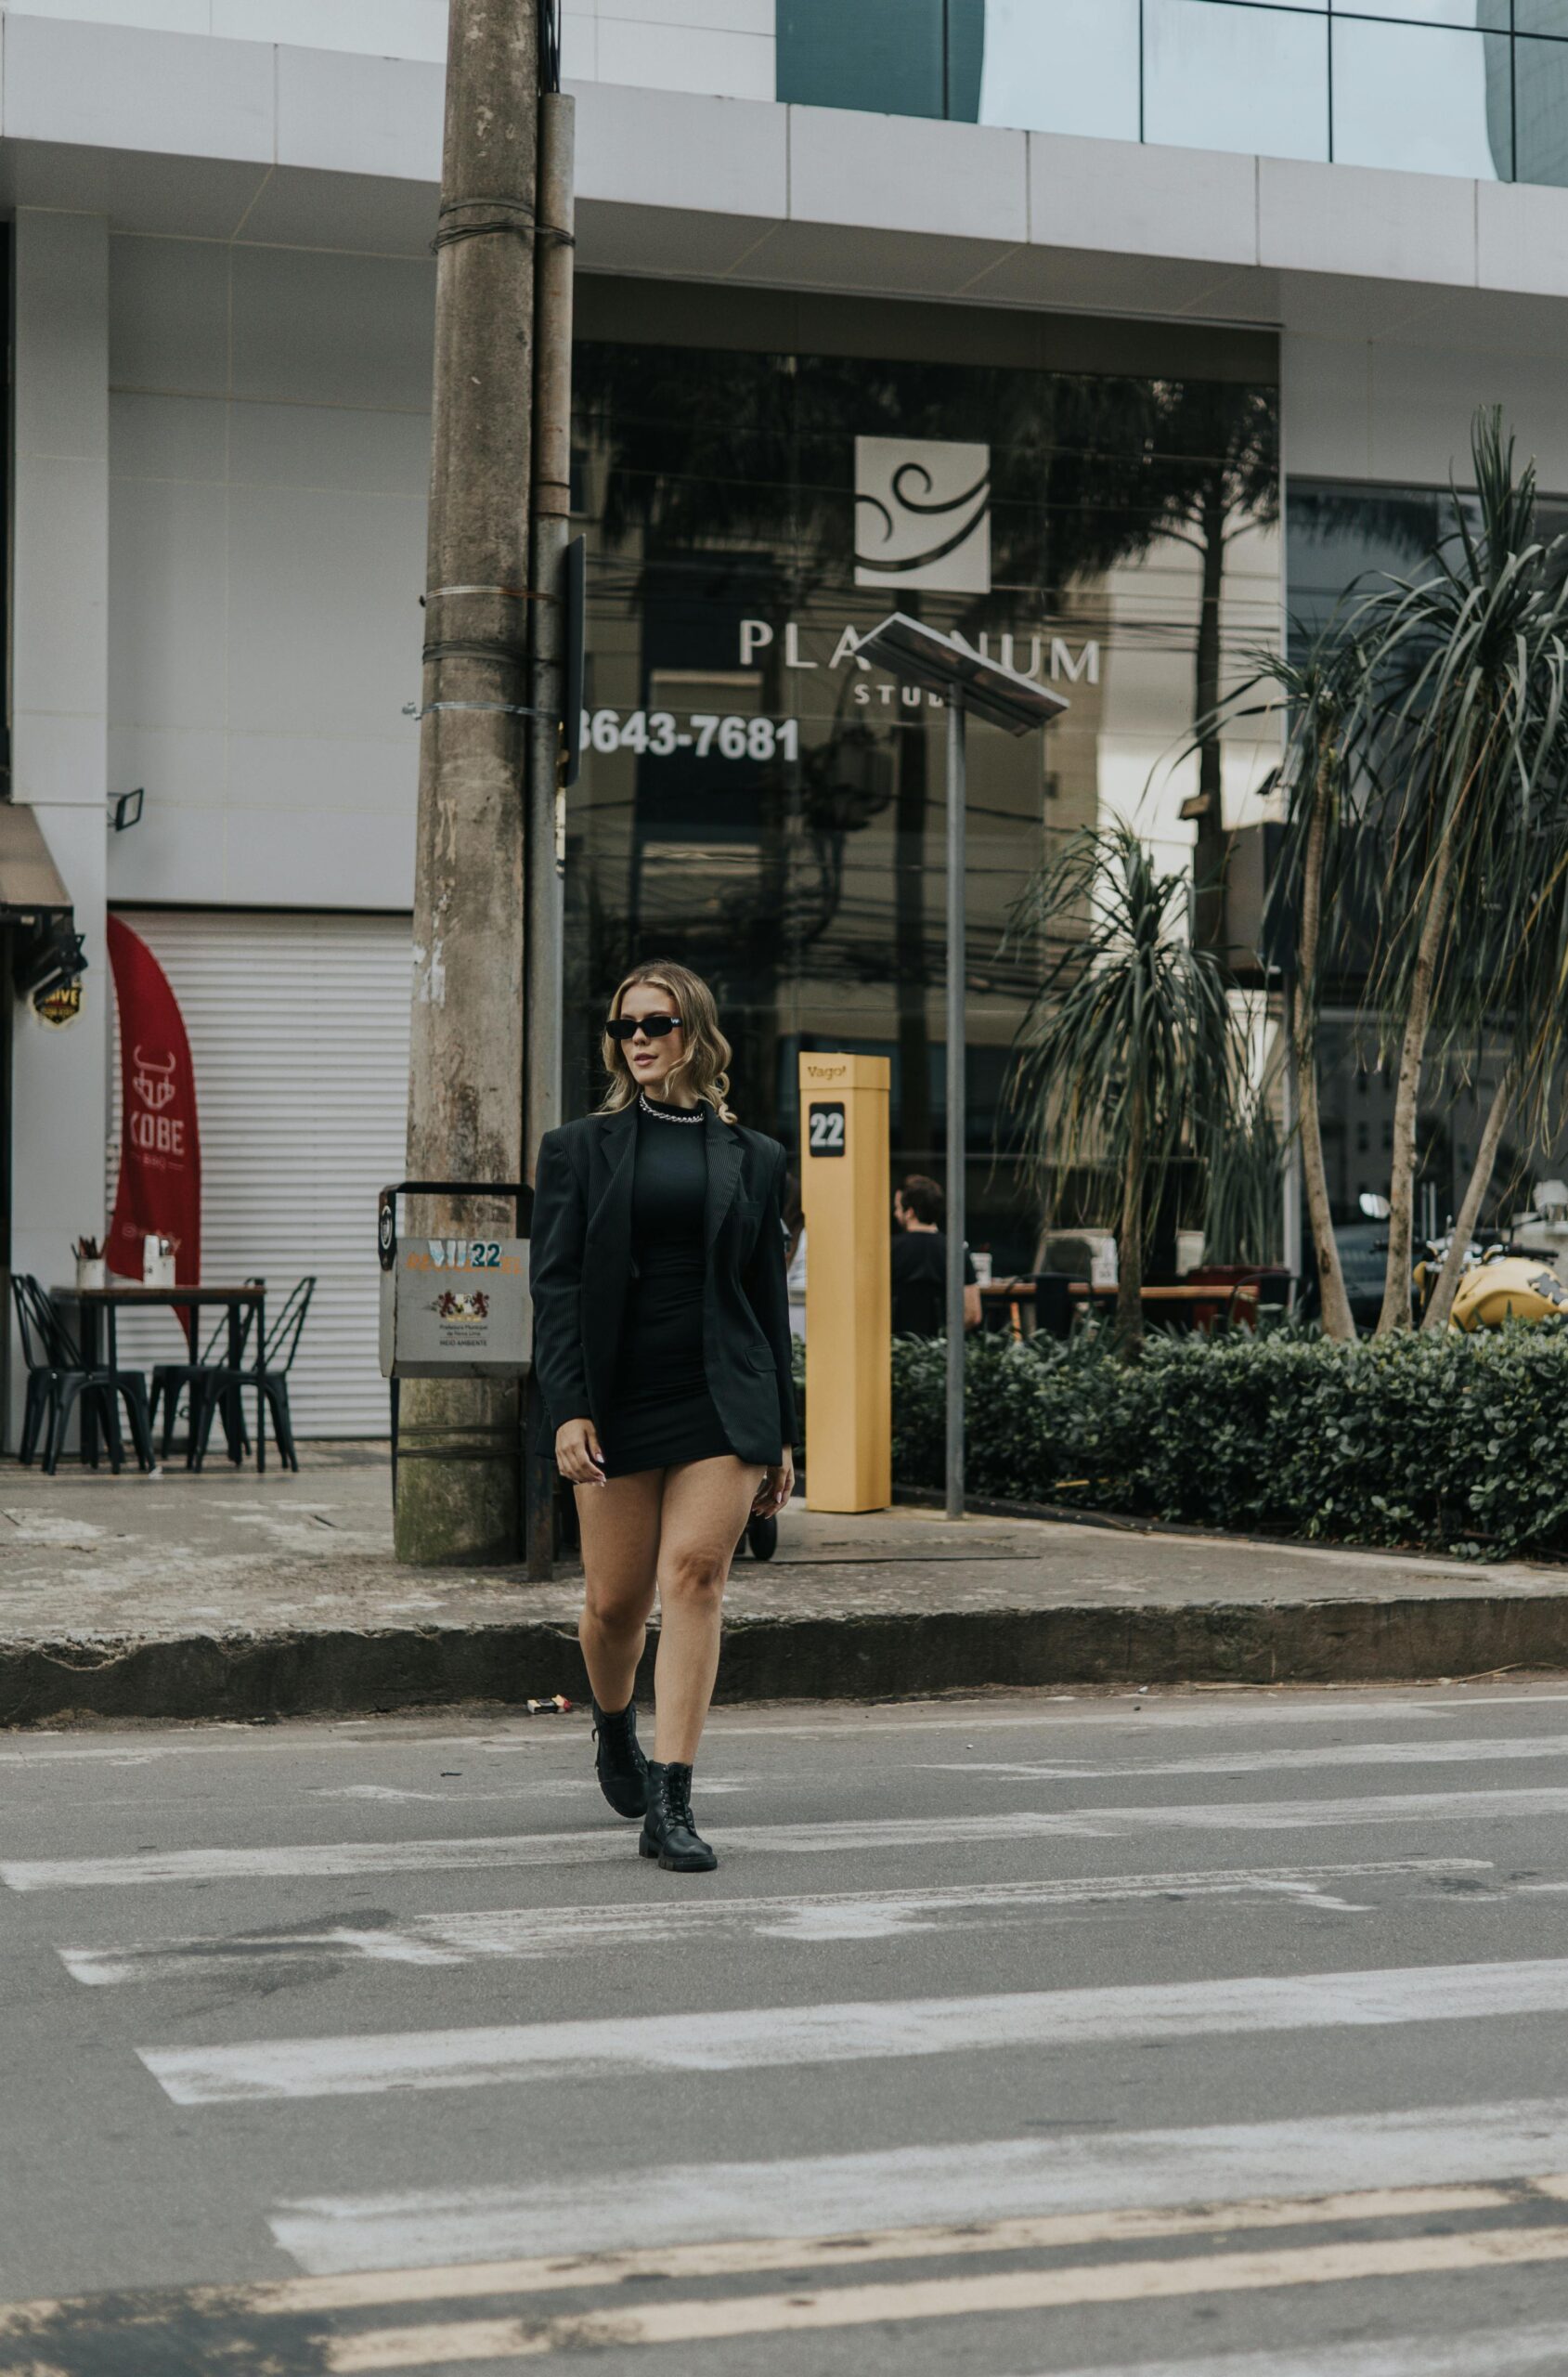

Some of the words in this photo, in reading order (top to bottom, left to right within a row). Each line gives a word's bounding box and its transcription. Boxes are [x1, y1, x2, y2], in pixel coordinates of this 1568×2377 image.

[740, 619, 1099, 684] PLAUM
[810, 1112, 845, 1148] 22
[471, 1243, 500, 1267] 22
